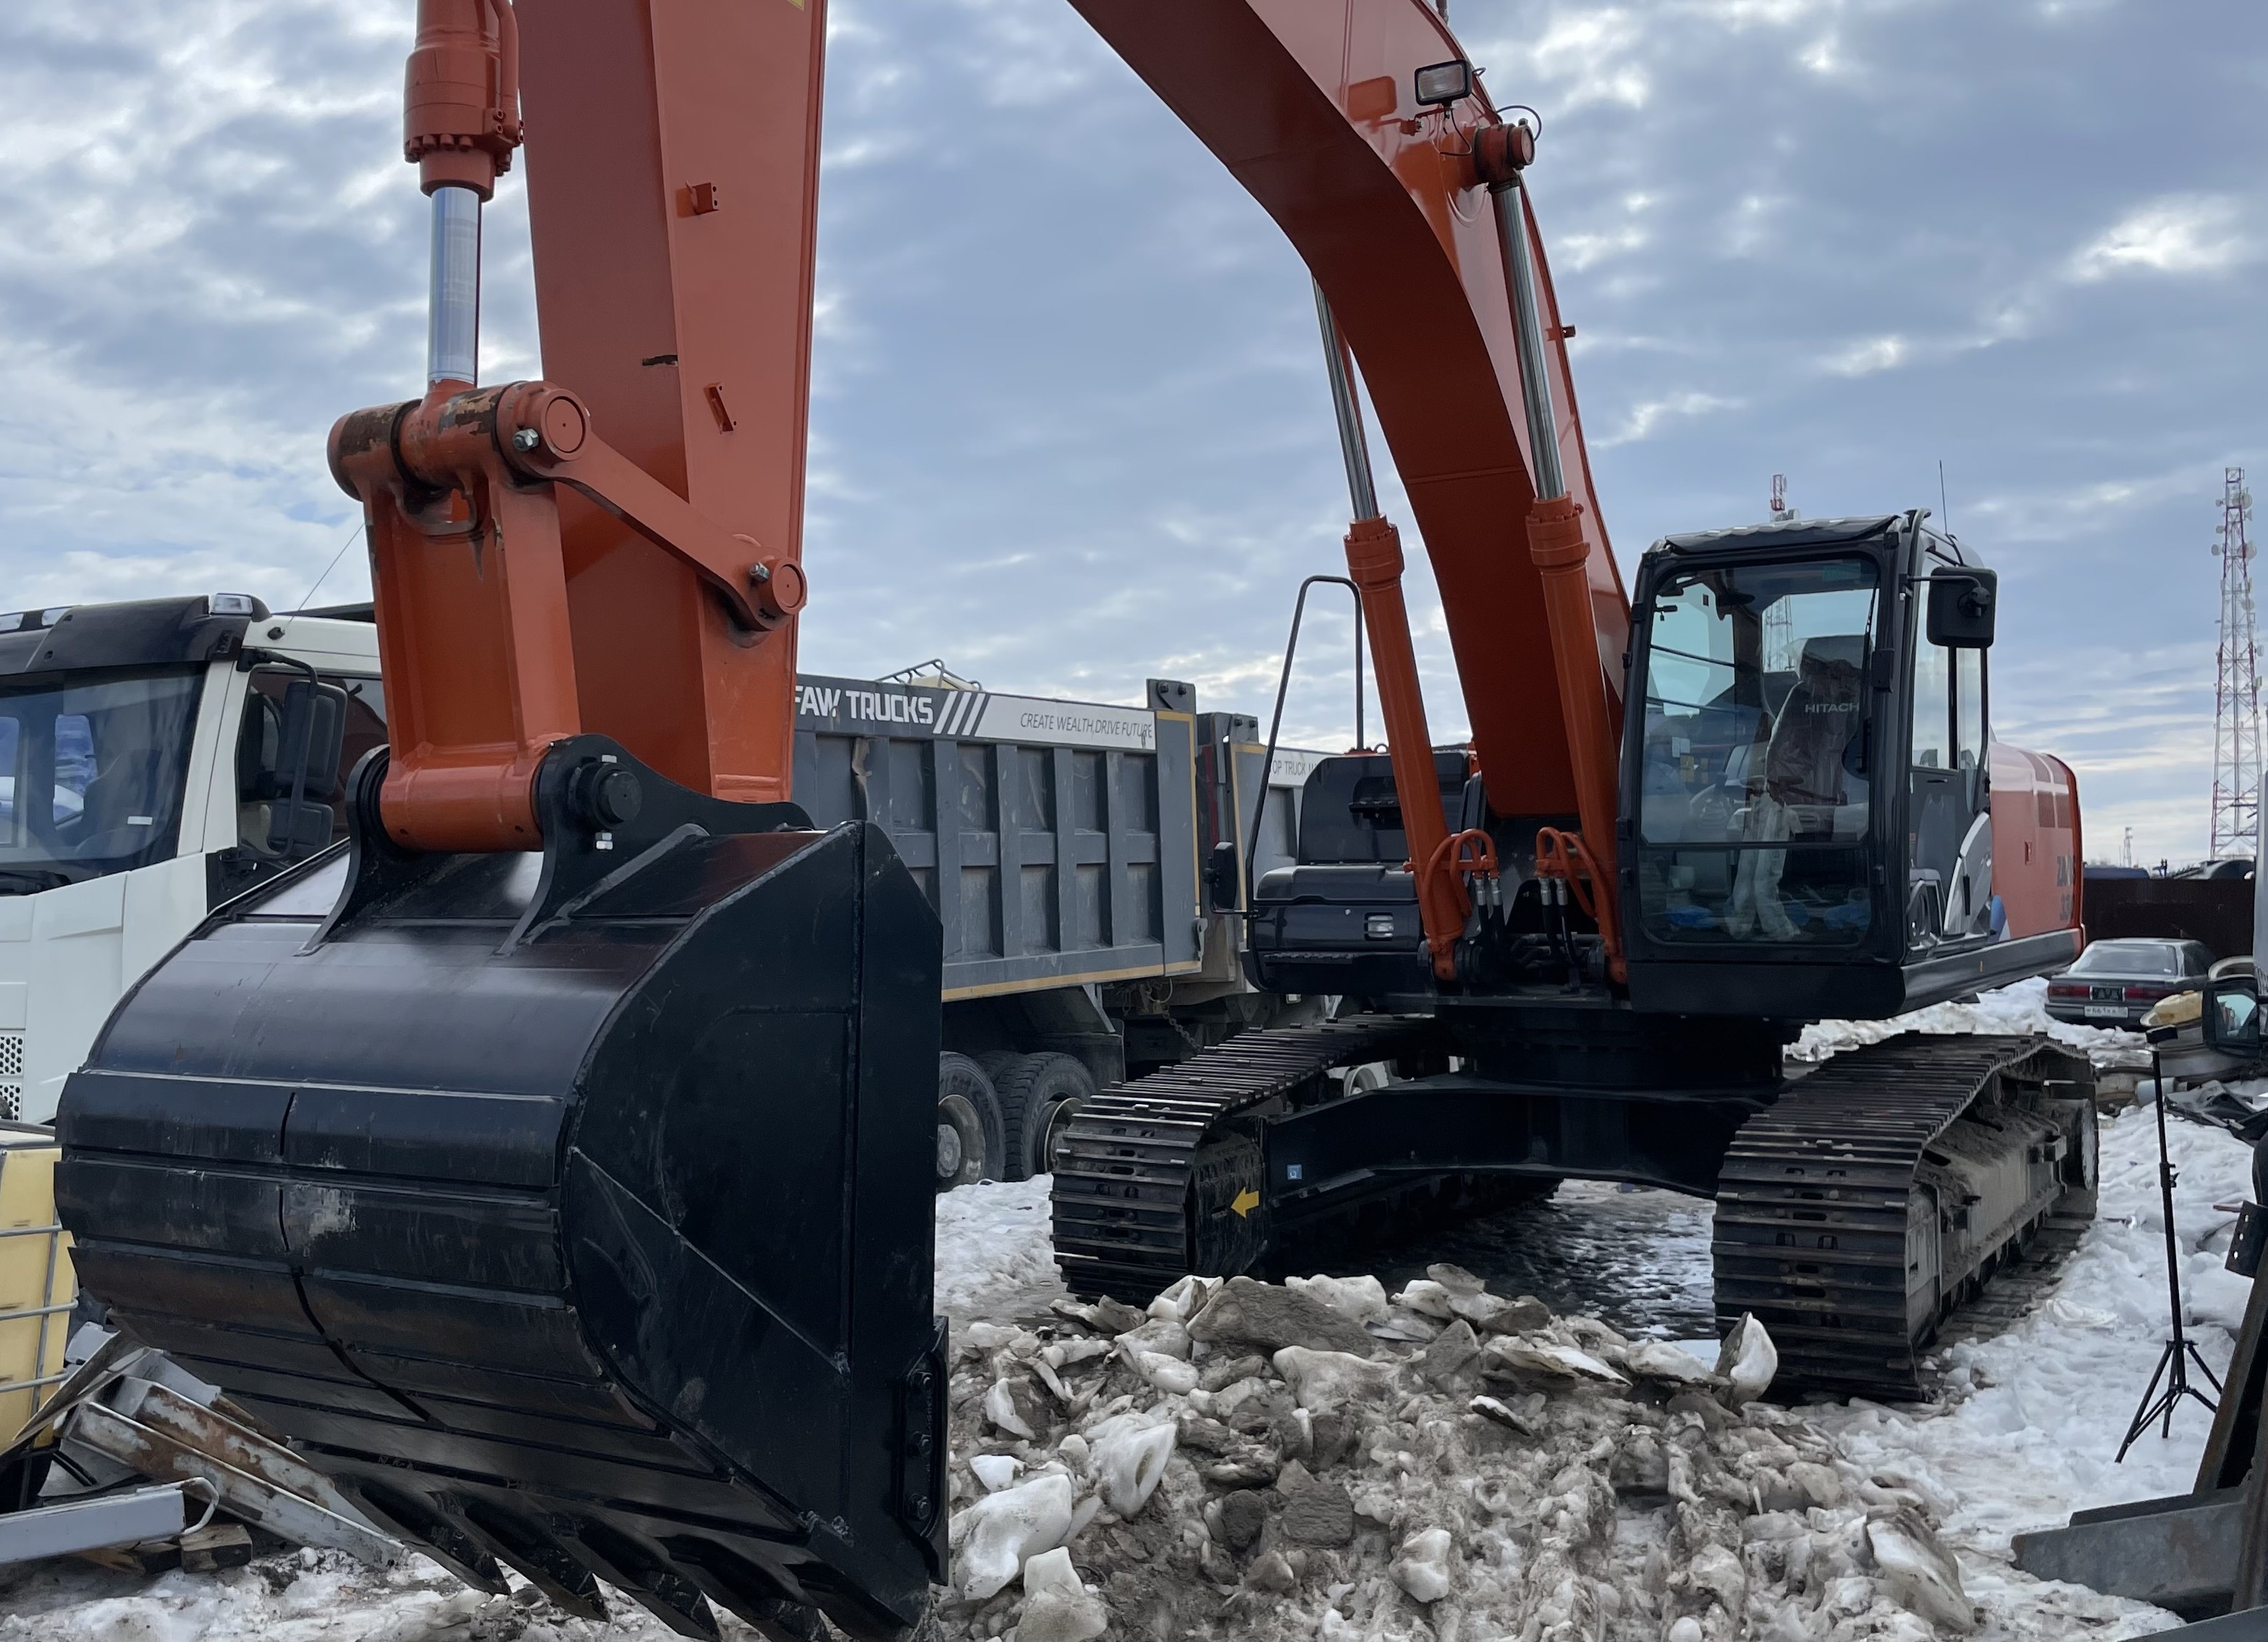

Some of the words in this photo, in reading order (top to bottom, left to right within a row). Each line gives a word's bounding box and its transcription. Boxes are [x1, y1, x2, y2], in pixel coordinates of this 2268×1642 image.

[794, 685, 841, 717] FAW
[846, 690, 934, 724] TRUCKS
[1805, 702, 1860, 713] HITACH
[1020, 712, 1055, 730] CREATE
[1122, 721, 1152, 738] FUTURE
[1284, 761, 1306, 776] TRUCK
